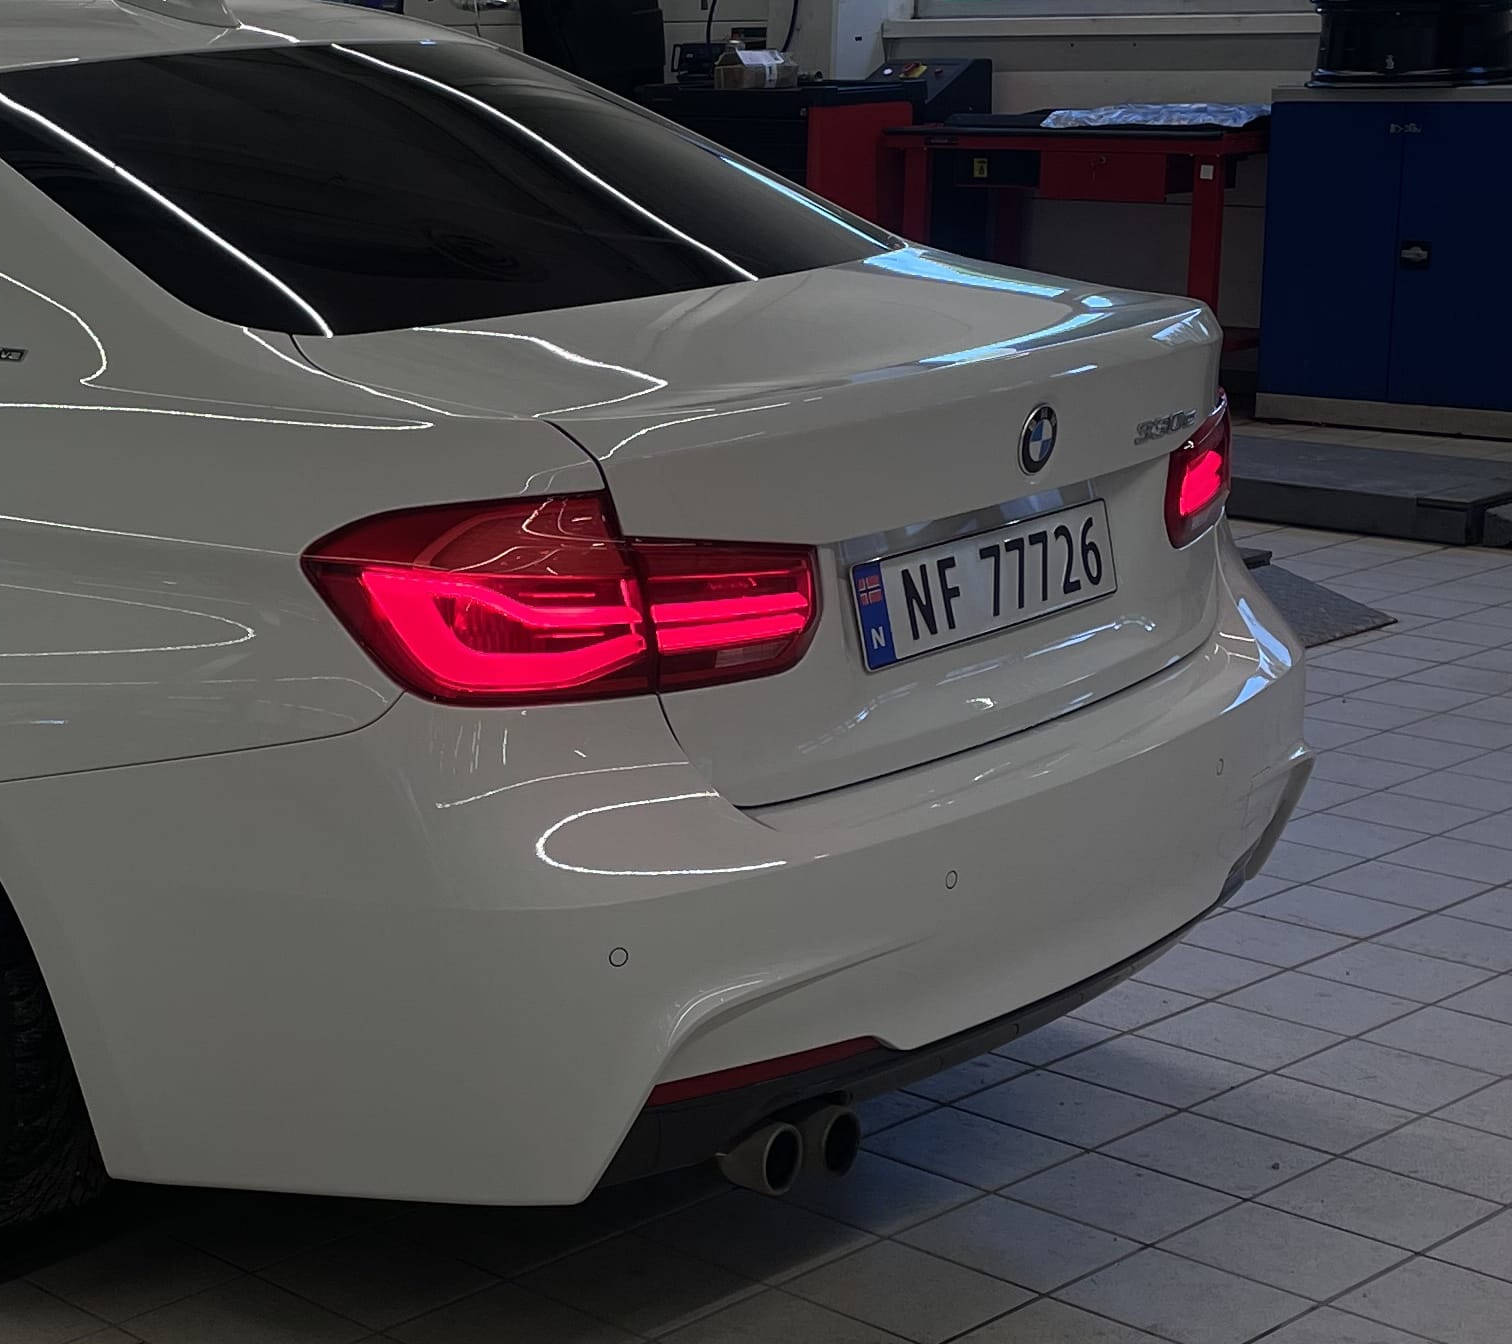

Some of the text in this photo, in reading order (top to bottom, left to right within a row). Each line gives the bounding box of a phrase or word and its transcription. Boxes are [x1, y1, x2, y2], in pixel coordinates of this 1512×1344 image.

[901, 516, 1103, 641] NF 77726
[870, 626, 886, 649] N
